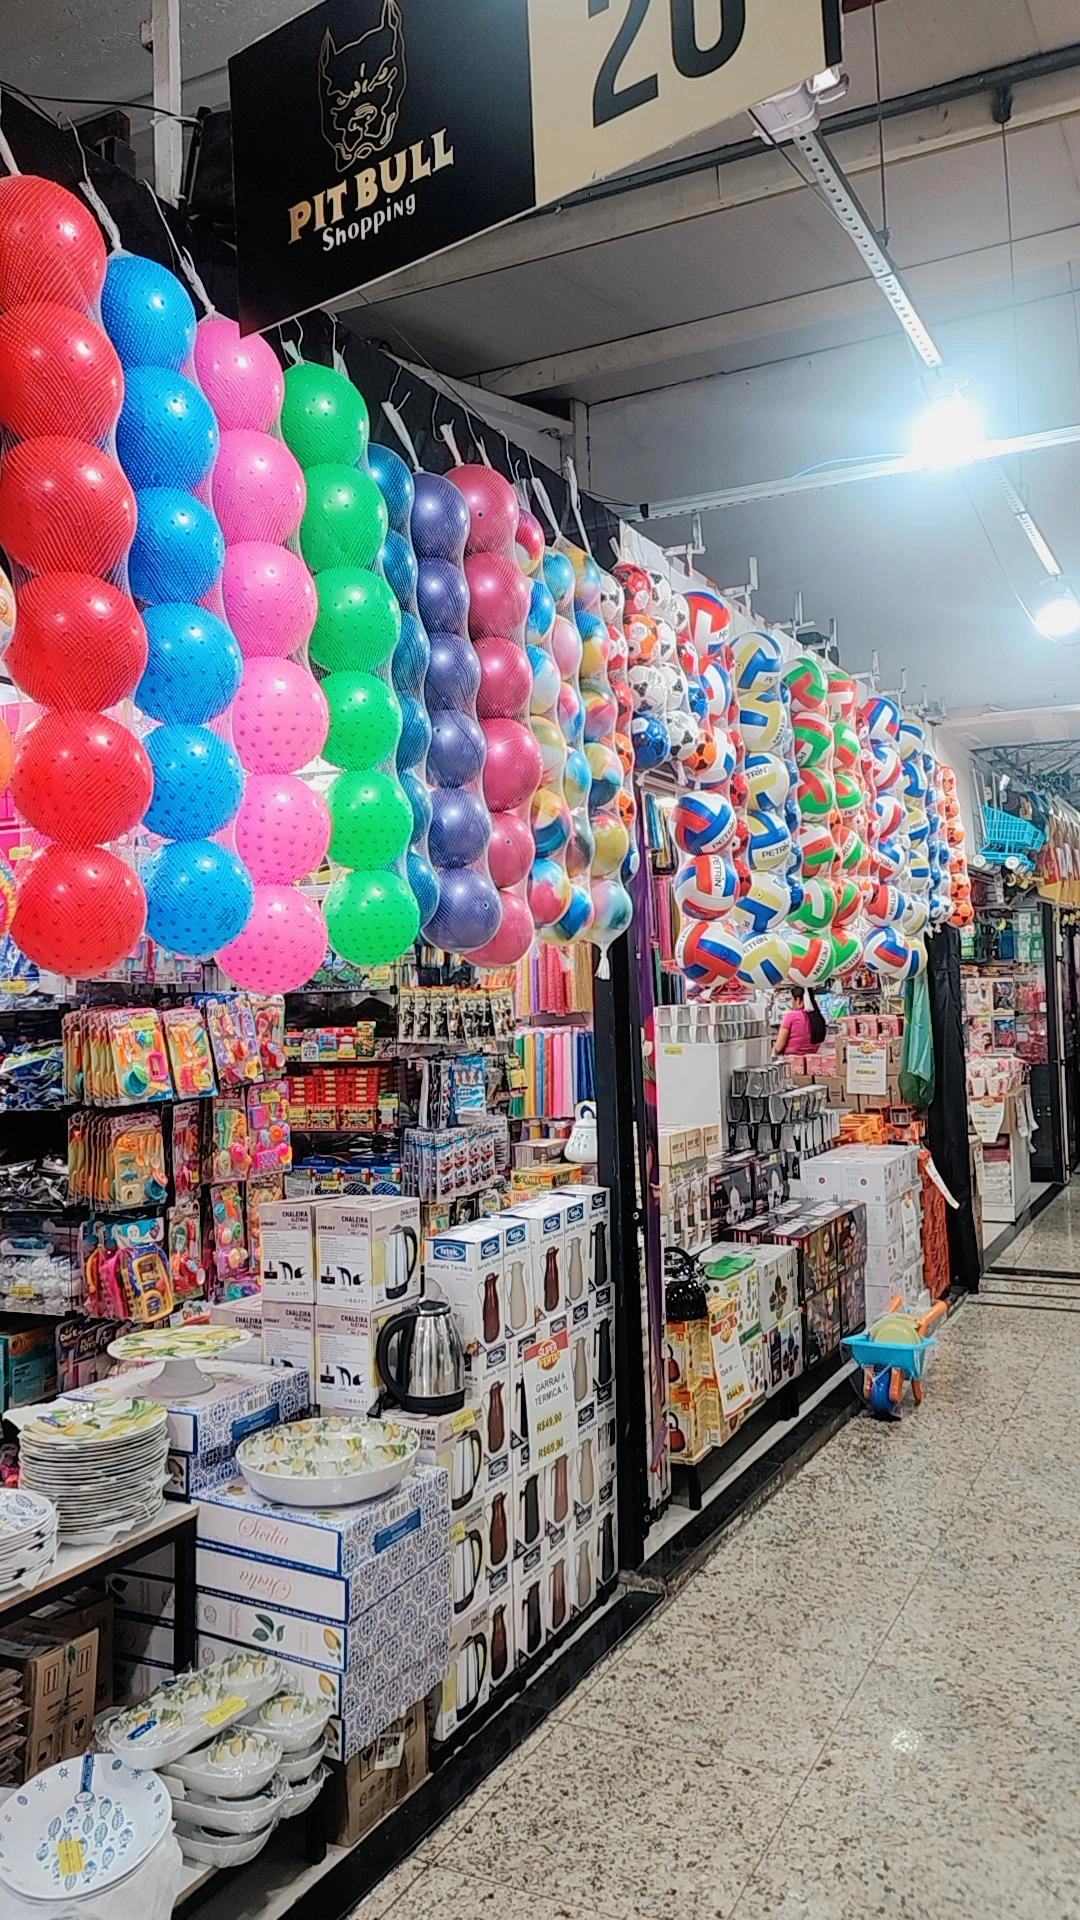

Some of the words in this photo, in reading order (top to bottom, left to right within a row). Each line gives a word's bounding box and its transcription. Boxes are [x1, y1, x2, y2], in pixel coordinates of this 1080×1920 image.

[288, 179, 348, 245] PIT
[354, 128, 454, 211] BULL
[535, 1372, 566, 1393] GARRAFA
[238, 1516, 290, 1545] Sicilia
